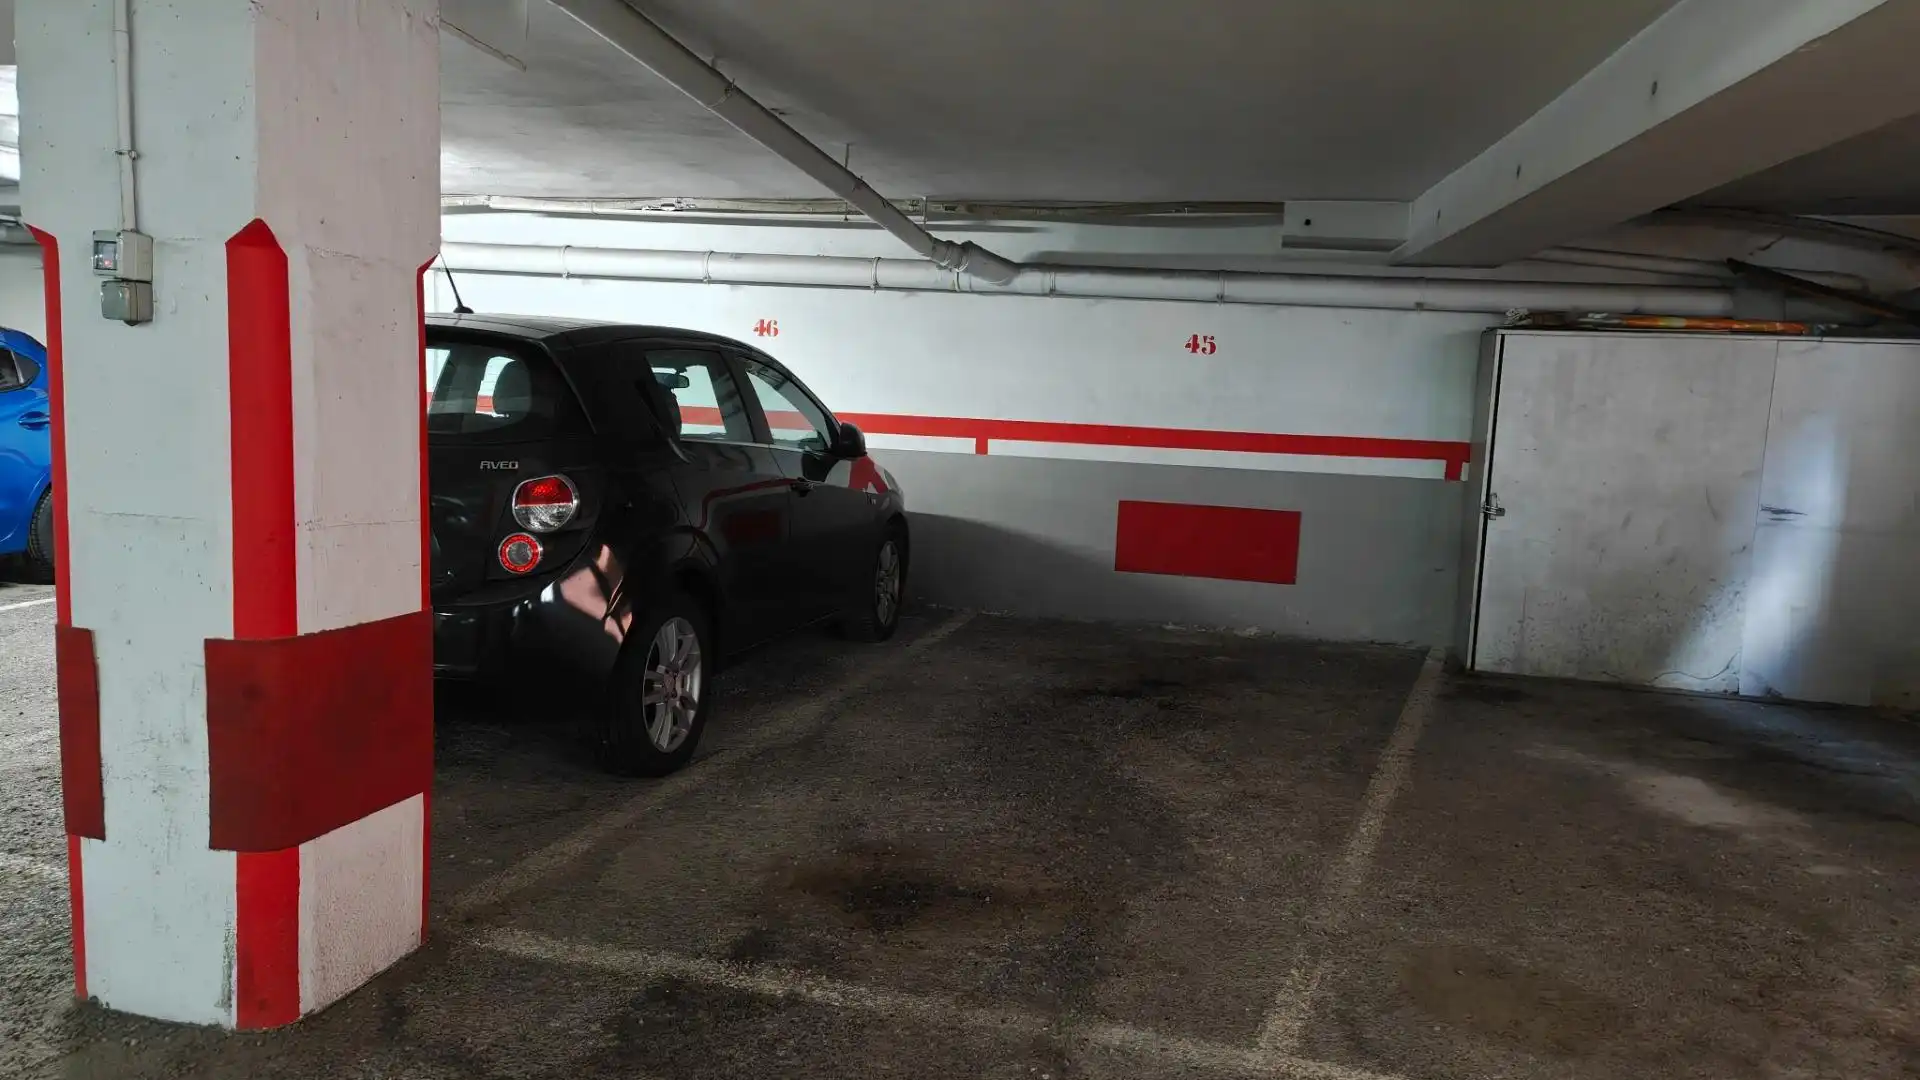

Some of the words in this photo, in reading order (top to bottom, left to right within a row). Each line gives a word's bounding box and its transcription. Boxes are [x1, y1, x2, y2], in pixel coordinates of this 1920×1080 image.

[753, 318, 779, 337] 46
[1184, 334, 1217, 355] 45
[479, 460, 519, 470] AVEO
